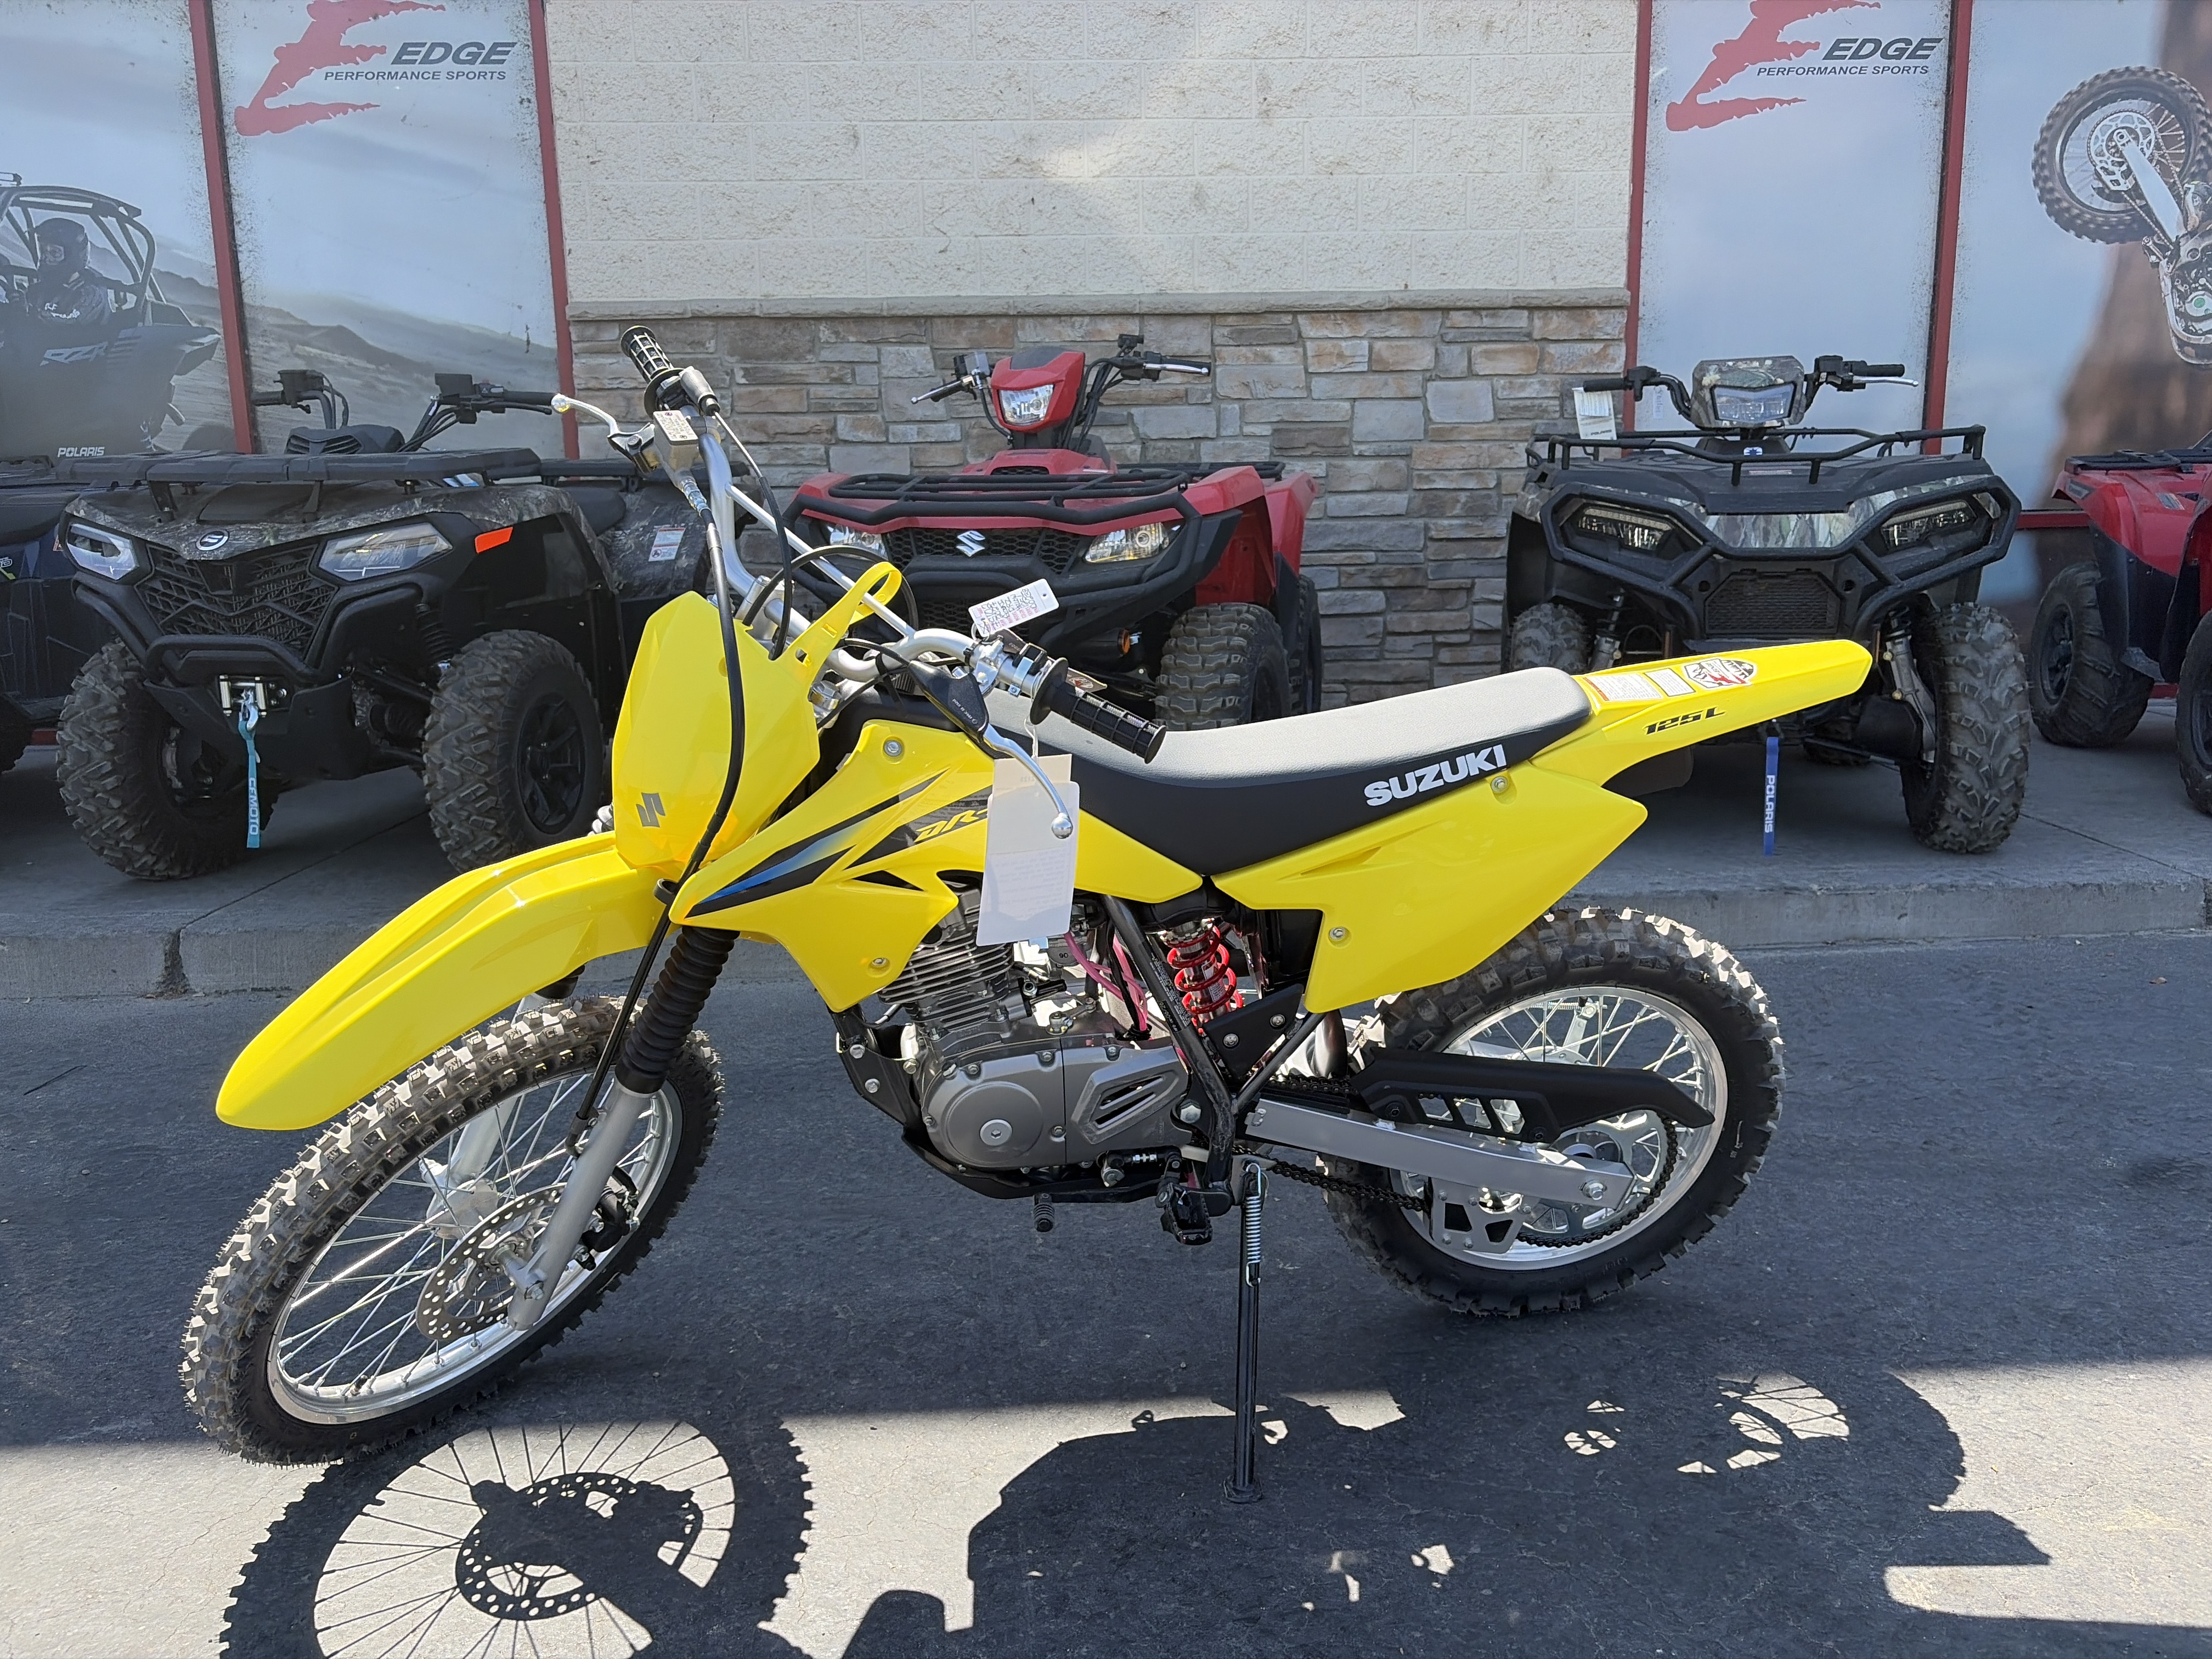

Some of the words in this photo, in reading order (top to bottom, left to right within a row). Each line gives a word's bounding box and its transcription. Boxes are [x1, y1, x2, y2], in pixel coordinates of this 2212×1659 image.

[391, 42, 518, 65] EDGE
[1821, 38, 1944, 61] EDGE
[324, 71, 442, 81] PERFORMANCE
[445, 70, 506, 80] SPORTS
[1757, 66, 1868, 76] PERFORMANCE
[1871, 65, 1929, 75] SPORTS
[57, 446, 105, 458] POLARIS
[1364, 743, 1507, 806] SUZUKI
[249, 777, 258, 835] CFMOTO
[1764, 774, 1776, 833] POLARIS
